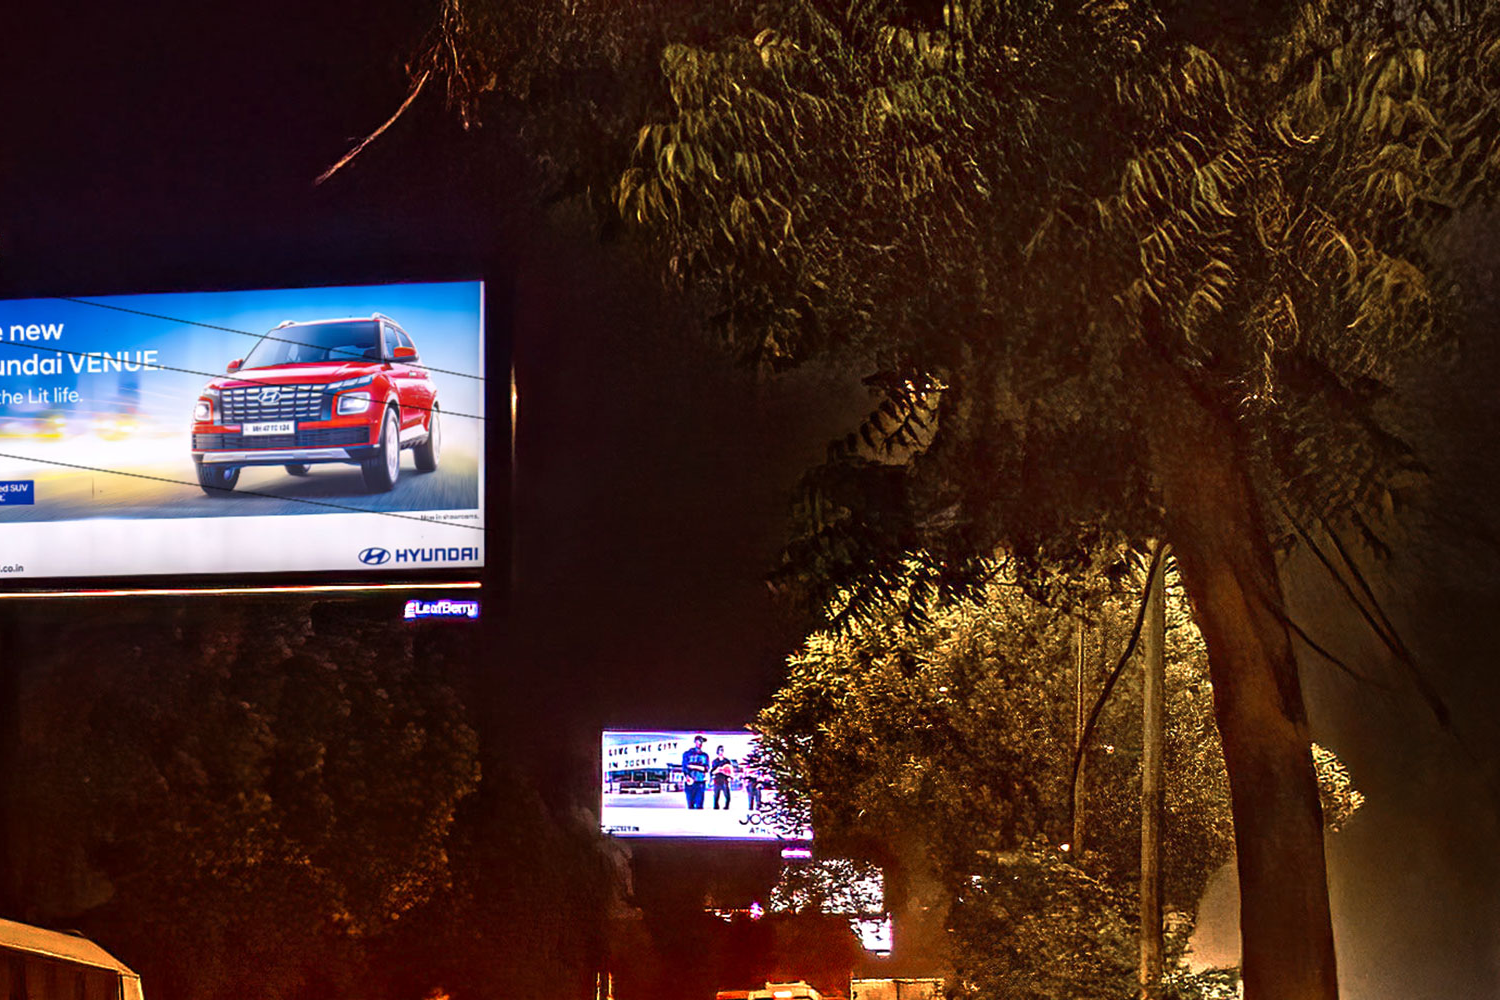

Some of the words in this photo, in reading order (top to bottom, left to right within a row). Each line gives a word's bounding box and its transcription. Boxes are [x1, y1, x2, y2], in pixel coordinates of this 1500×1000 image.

[9, 323, 64, 341] new
[67, 350, 165, 374] VENUE.
[28, 388, 49, 404] Lit
[53, 386, 84, 404] life.
[10, 484, 28, 492] SUV
[395, 547, 479, 562] HYUNDAI
[608, 747, 628, 757] LIVE
[635, 744, 651, 753] THE
[657, 742, 677, 751] CITY
